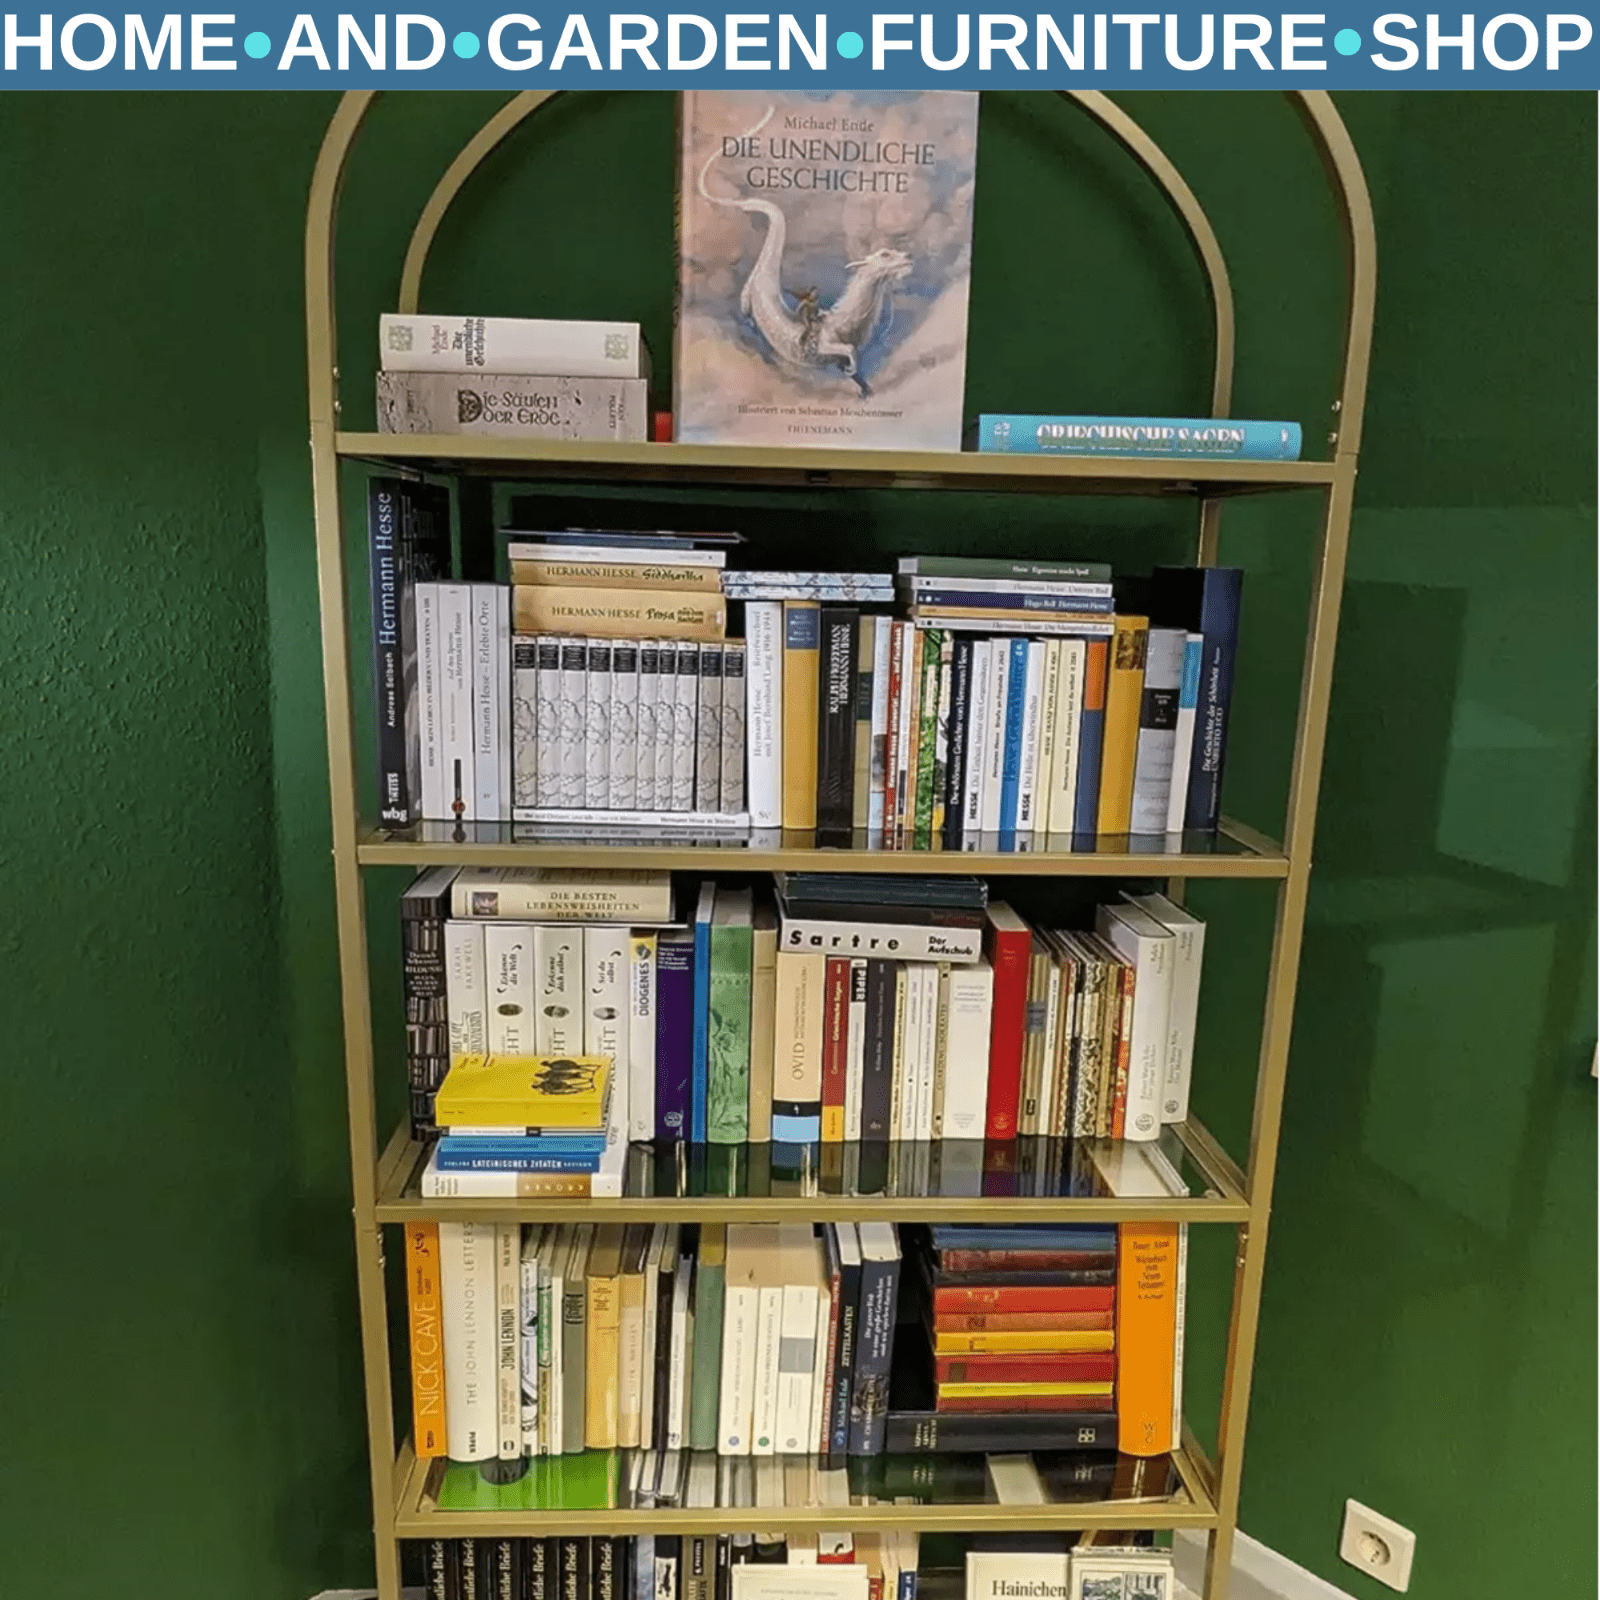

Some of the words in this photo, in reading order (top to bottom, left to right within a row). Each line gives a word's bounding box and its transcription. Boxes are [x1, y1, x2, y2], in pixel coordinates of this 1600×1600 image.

[784, 116, 836, 131] Michael
[842, 118, 874, 132] Ende
[722, 136, 761, 159] DIE
[769, 138, 936, 166] UNENDLICHE
[746, 166, 909, 193] GESCHICHTE
[376, 493, 393, 547] Hesse
[546, 565, 601, 577] HERMANN
[602, 567, 638, 579] HESSE
[642, 567, 704, 583] Siddhartha
[376, 555, 397, 646] Hermann
[478, 601, 490, 626] Orte
[551, 606, 605, 618] HERMANN
[606, 607, 641, 619] HESSE
[645, 607, 676, 621] Prosa
[478, 627, 491, 664] Erlebte
[958, 645, 968, 669] Hesse
[479, 675, 491, 705] Hesse
[956, 669, 966, 706] Hermann
[387, 686, 396, 728] Andreas
[956, 705, 964, 721] von
[479, 706, 491, 755] Hermann
[1202, 757, 1212, 771] Die
[1207, 704, 1216, 717] der
[950, 791, 959, 805] Die
[969, 792, 978, 820] HESSE
[1021, 793, 1031, 821] HESSE
[382, 806, 408, 825] wbg
[526, 900, 641, 911] LEBENSWEISHEITEN
[550, 891, 568, 901] DIE
[574, 892, 617, 902] BESTEN
[557, 911, 578, 919] DER
[584, 911, 614, 919] WELT
[789, 930, 899, 951] Sartre
[928, 936, 947, 945] Der
[928, 945, 973, 956] Aufschub
[500, 952, 508, 985] Erkenne
[509, 953, 518, 972] Welt
[597, 961, 606, 971] du
[510, 973, 518, 985] die
[597, 972, 606, 983] Sei
[638, 962, 650, 1016] DIOGENES
[855, 969, 867, 1000] PIPER
[792, 1042, 806, 1081] OVID
[462, 1221, 475, 1272] LETTERS
[464, 1277, 476, 1334] LENNON
[412, 1299, 437, 1355] CAVE
[500, 1308, 515, 1344] LENNON
[841, 1305, 853, 1368] ZETTELKASTEN
[465, 1339, 477, 1376] JOHN
[501, 1345, 516, 1371] JOHN
[416, 1361, 440, 1416] NICK
[466, 1383, 477, 1405] THE
[469, 1431, 477, 1454] PIPER
[431, 1541, 445, 1570] Briefe
[462, 1538, 475, 1567] Briefe
[499, 1541, 511, 1571] Briefe
[531, 1543, 544, 1573] Briefe
[564, 1542, 577, 1571] Briefe
[600, 1542, 612, 1571] Briefe
[991, 1579, 1068, 1598] Hainichen
